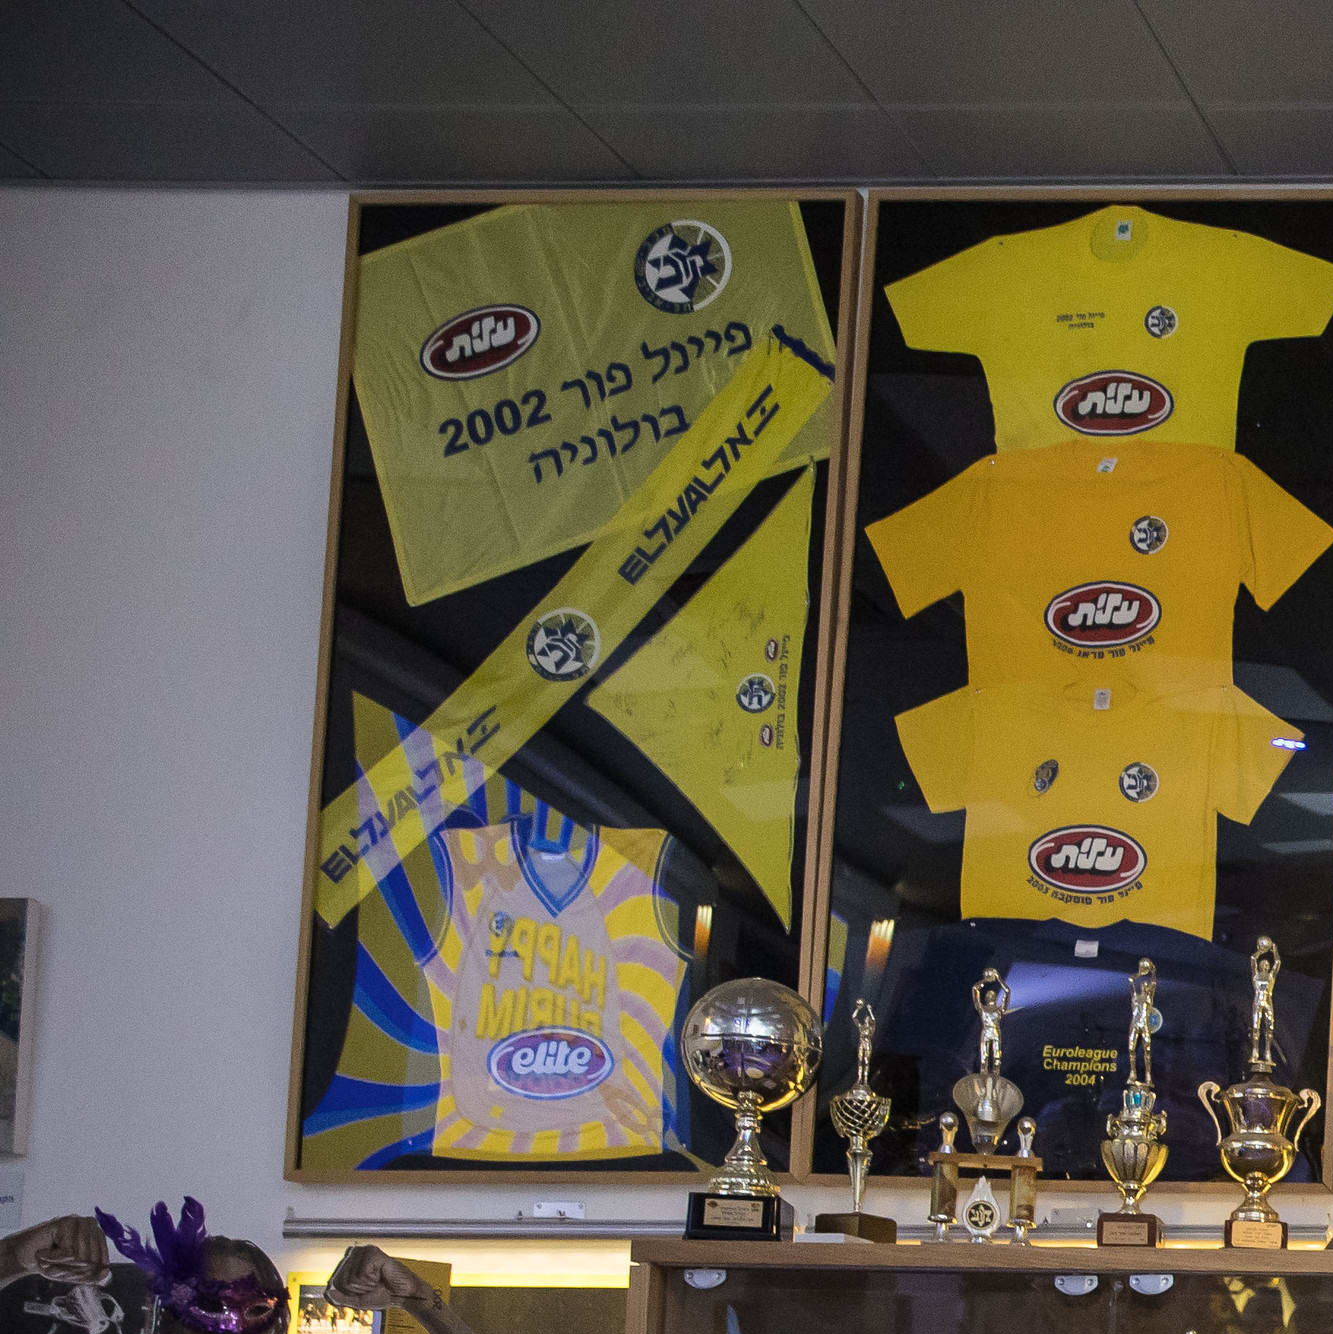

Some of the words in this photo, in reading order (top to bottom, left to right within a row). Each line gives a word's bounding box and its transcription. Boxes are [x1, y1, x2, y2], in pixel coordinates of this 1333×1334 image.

[445, 316, 516, 362] עלית
[640, 321, 753, 384] פיינל
[561, 362, 633, 409] פור
[1078, 382, 1151, 415] עלית
[438, 388, 552, 457] 2002
[528, 404, 690, 484] בולוניה
[1067, 593, 1140, 626] עלית
[1050, 837, 1124, 871] עלית
[511, 1040, 592, 1075] elite
[1042, 1044, 1118, 1061] Euroleague
[1043, 1058, 1118, 1073] Champions
[1065, 1073, 1097, 1086] 2004
